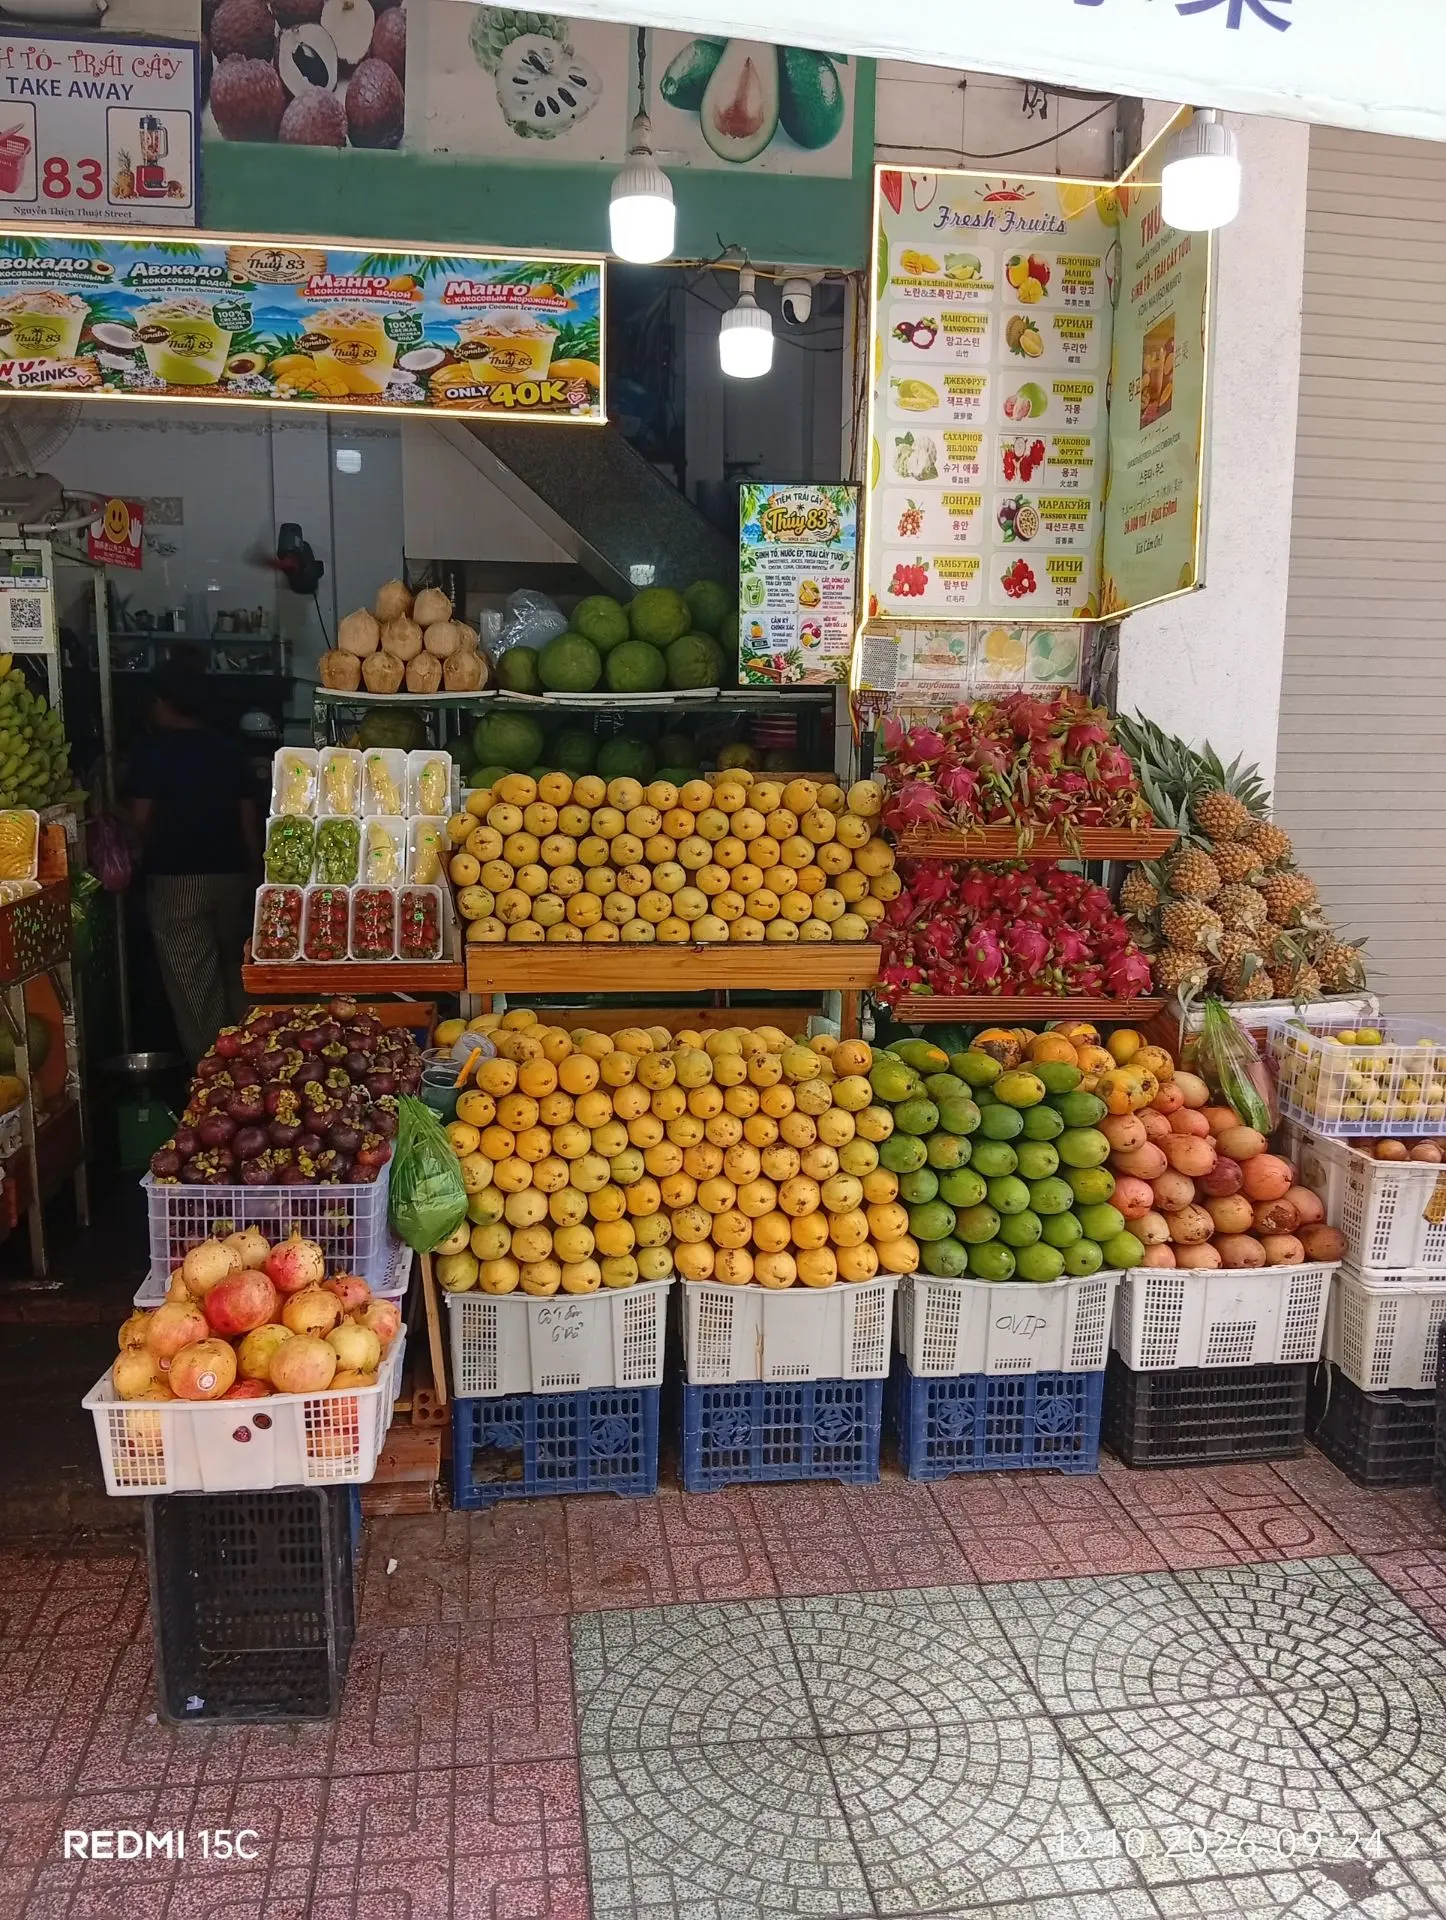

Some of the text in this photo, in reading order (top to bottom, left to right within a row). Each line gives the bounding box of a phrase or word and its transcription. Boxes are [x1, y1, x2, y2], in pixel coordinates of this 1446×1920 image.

[68, 49, 125, 78] TRÁI
[131, 53, 183, 80] CÂY
[6, 76, 134, 101] TAKE AWAY
[42, 156, 104, 200] 83
[13, 205, 47, 218] Nguyễn
[49, 207, 75, 217] Thiện
[105, 209, 133, 219] Street
[933, 205, 1067, 233] Fresh Fruits
[1140, 203, 1166, 248] THU
[285, 259, 305, 270] 83
[1056, 257, 1101, 267] ЯБЛОЧНЫЙ
[130, 262, 223, 278] Авокадо
[1064, 269, 1092, 278] МАНГО
[57, 281, 99, 289] Ice-cream
[142, 277, 197, 286] кокосовой
[200, 278, 232, 288] водой
[310, 275, 388, 288] Манго
[224, 289, 246, 297] Water
[314, 287, 372, 296] кокосовой
[376, 290, 411, 299] водой
[447, 281, 528, 296] Манго
[392, 299, 413, 307] Water
[509, 297, 567, 307] мороженым
[217, 310, 245, 318] 100%
[520, 305, 558, 313] Ice-cream
[388, 320, 416, 328] 100%
[940, 314, 989, 325] МАНГОСТИН
[1053, 318, 1093, 329] ДУРИАН
[45, 333, 61, 342] 83
[945, 336, 980, 348] 망고스틴
[198, 340, 213, 350] 83
[1062, 342, 1088, 354] 두리안
[362, 349, 378, 358] 83
[518, 357, 533, 366] 83
[17, 366, 78, 385] DRINKS
[943, 376, 988, 386] ДЖЕКФРУТ
[446, 380, 568, 408] ONLY 40K
[948, 387, 982, 395] JACKFRUIT
[1052, 384, 1094, 394] ПОМЕЛО
[942, 433, 983, 442] САХАРНОЕ
[1052, 437, 1091, 446] ДРАКОНОВ
[946, 444, 978, 452] ЯБЛОКО
[1059, 448, 1084, 456] ФРУКТ
[941, 495, 981, 506] ЛОНГАН
[1038, 499, 1091, 510] МАРАКУЙЯ
[948, 508, 974, 516] LONGAN
[1040, 512, 1067, 520] PASSION
[767, 507, 829, 536] Thúy 83
[754, 551, 770, 560] SINH
[933, 559, 980, 569] РАМБУТАН
[1045, 560, 1083, 573] ЛИЧИ
[938, 571, 974, 579] RAMBUTAN
[1051, 576, 1078, 584] LYCHEE
[943, 580, 969, 591] 람부탄
[1055, 586, 1073, 597] 리치
[917, 681, 961, 690] клубника
